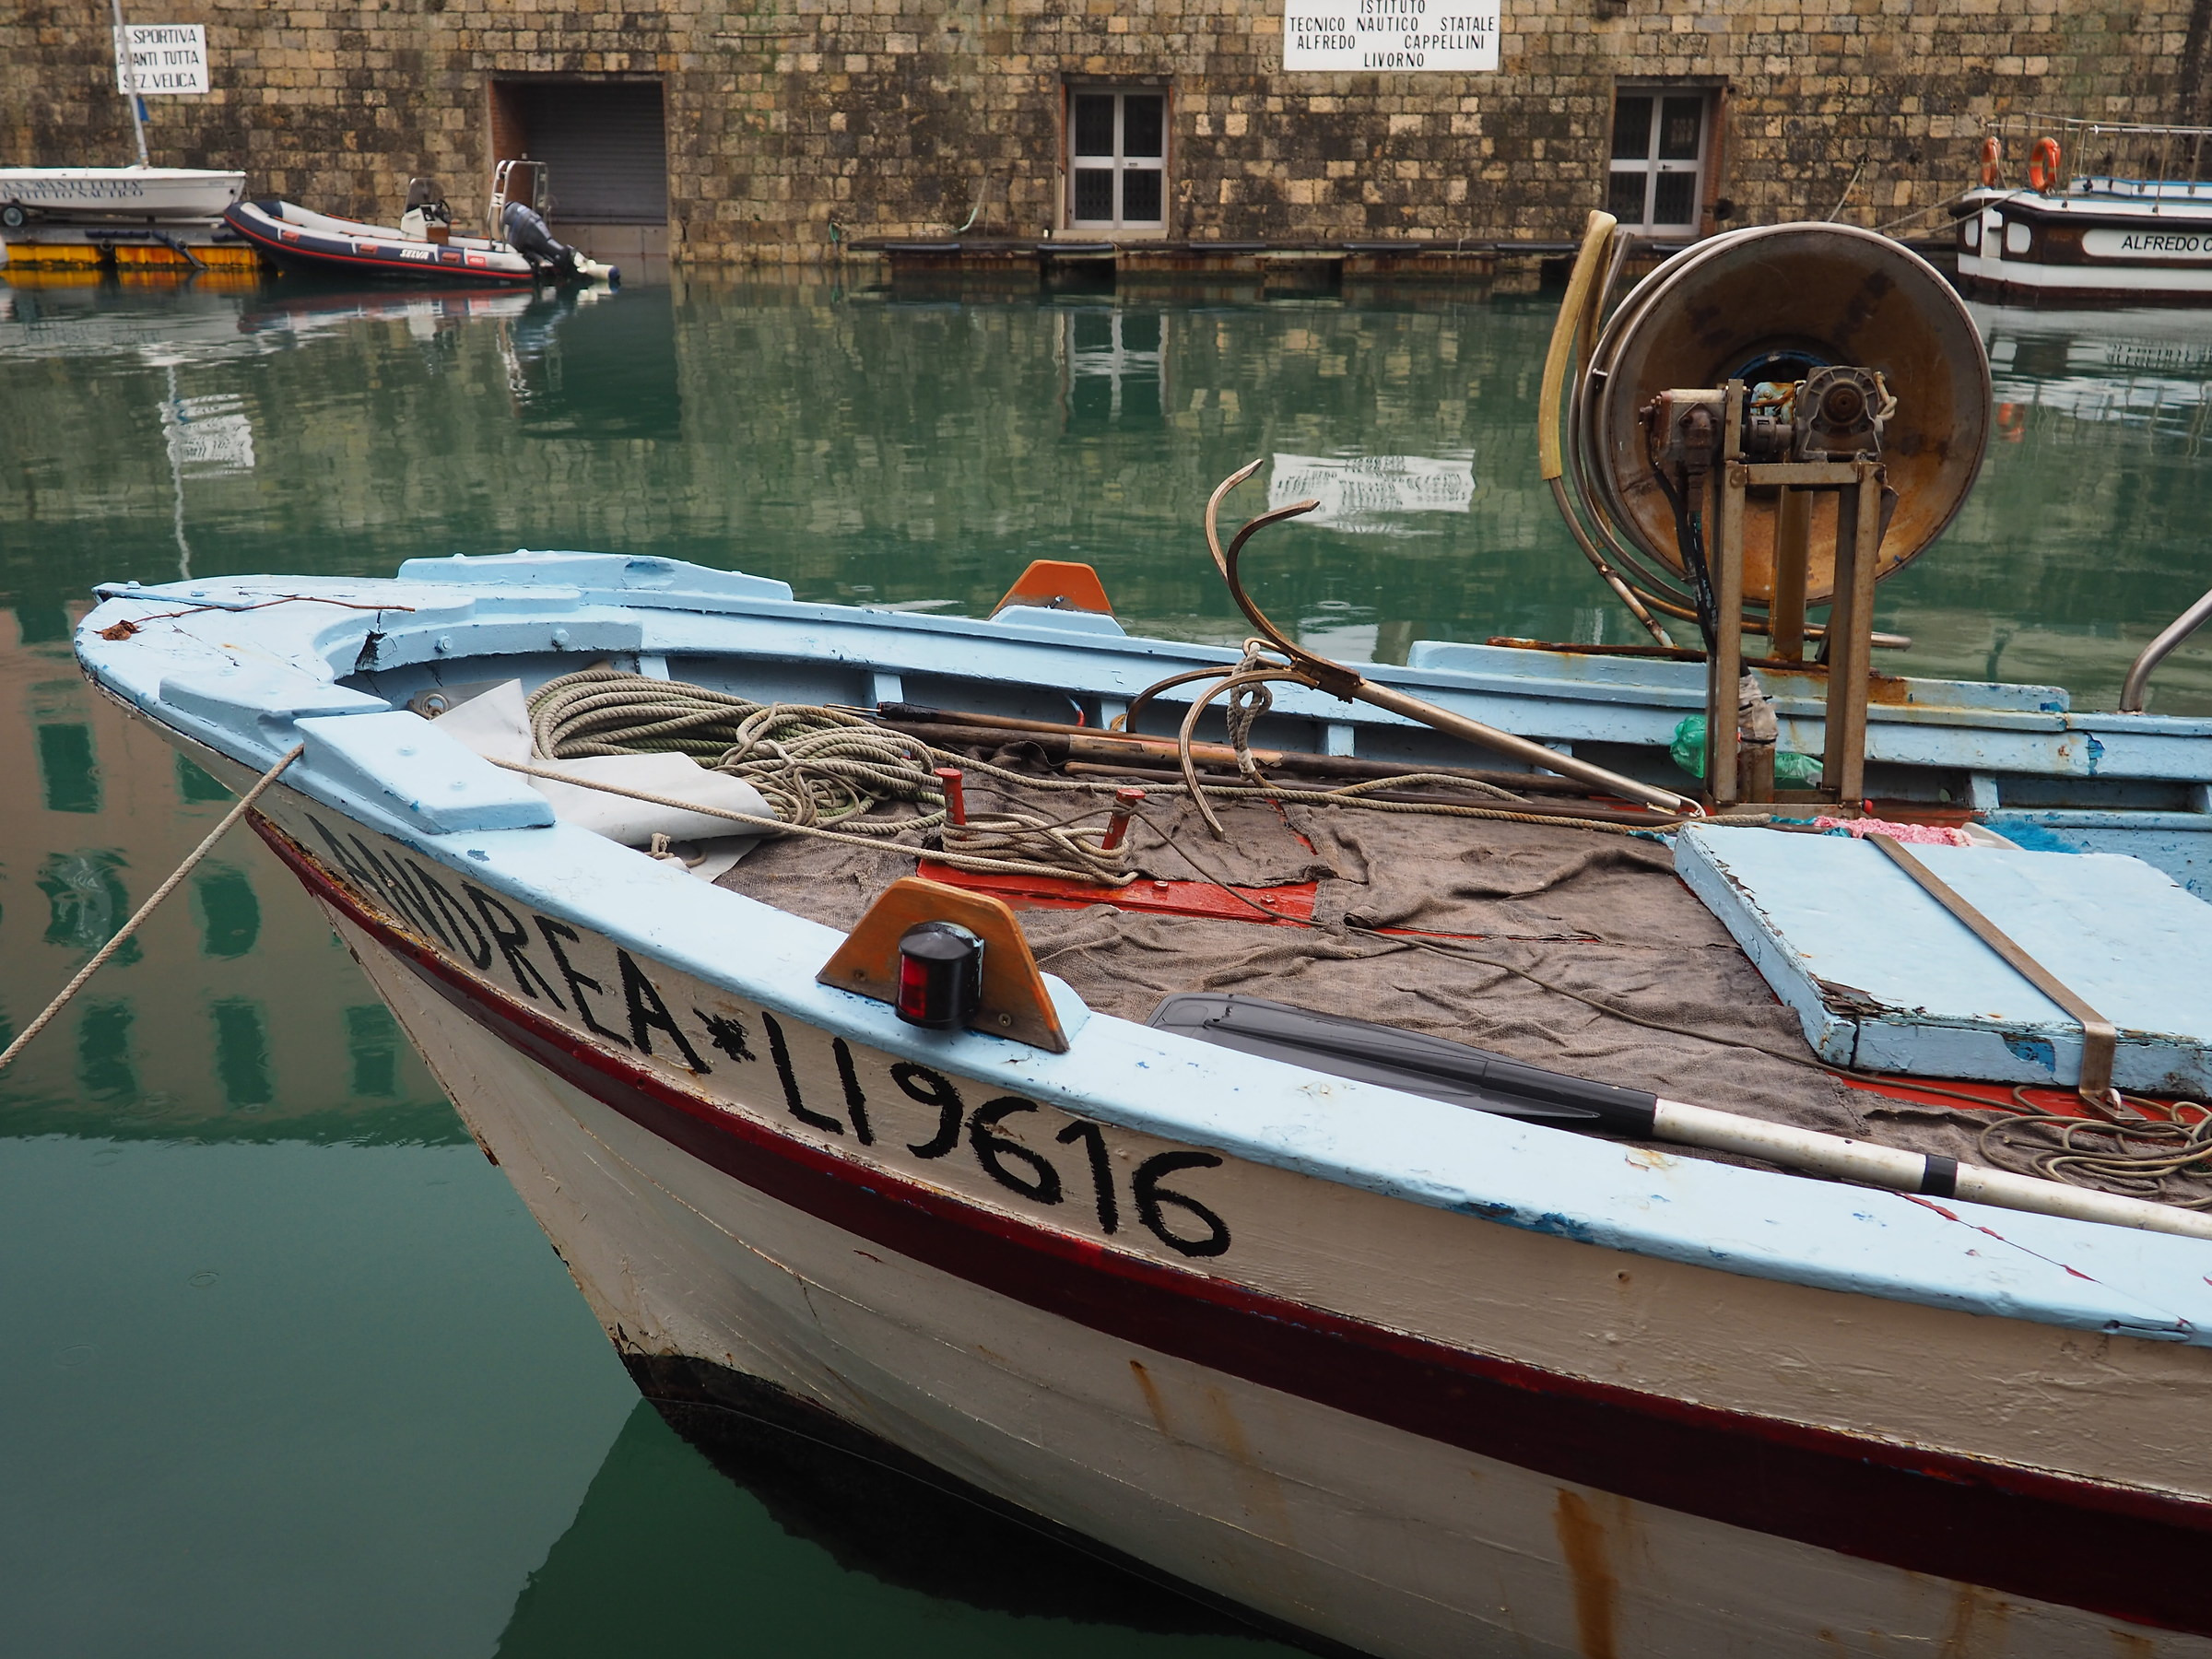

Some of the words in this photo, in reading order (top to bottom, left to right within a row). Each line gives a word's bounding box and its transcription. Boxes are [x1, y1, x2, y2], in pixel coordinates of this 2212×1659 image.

[1360, 0, 1425, 14] ISTITUTO
[1290, 17, 1345, 31] TECNICO
[1357, 17, 1418, 31] NAUTICO
[1441, 17, 1495, 31] STATALE
[134, 29, 196, 43] SPORTIVA
[1297, 35, 1356, 50] ALFREDO
[1404, 34, 1485, 50] CAPPELLINI
[163, 50, 200, 65] TUTTA
[1364, 53, 1424, 67] LIVORNO
[152, 72, 197, 88] VELICA
[77, 188, 144, 199] NAUTICO
[2121, 235, 2199, 252] ALFREDO
[399, 249, 429, 261] SELVA
[304, 813, 712, 1074] ANDREA
